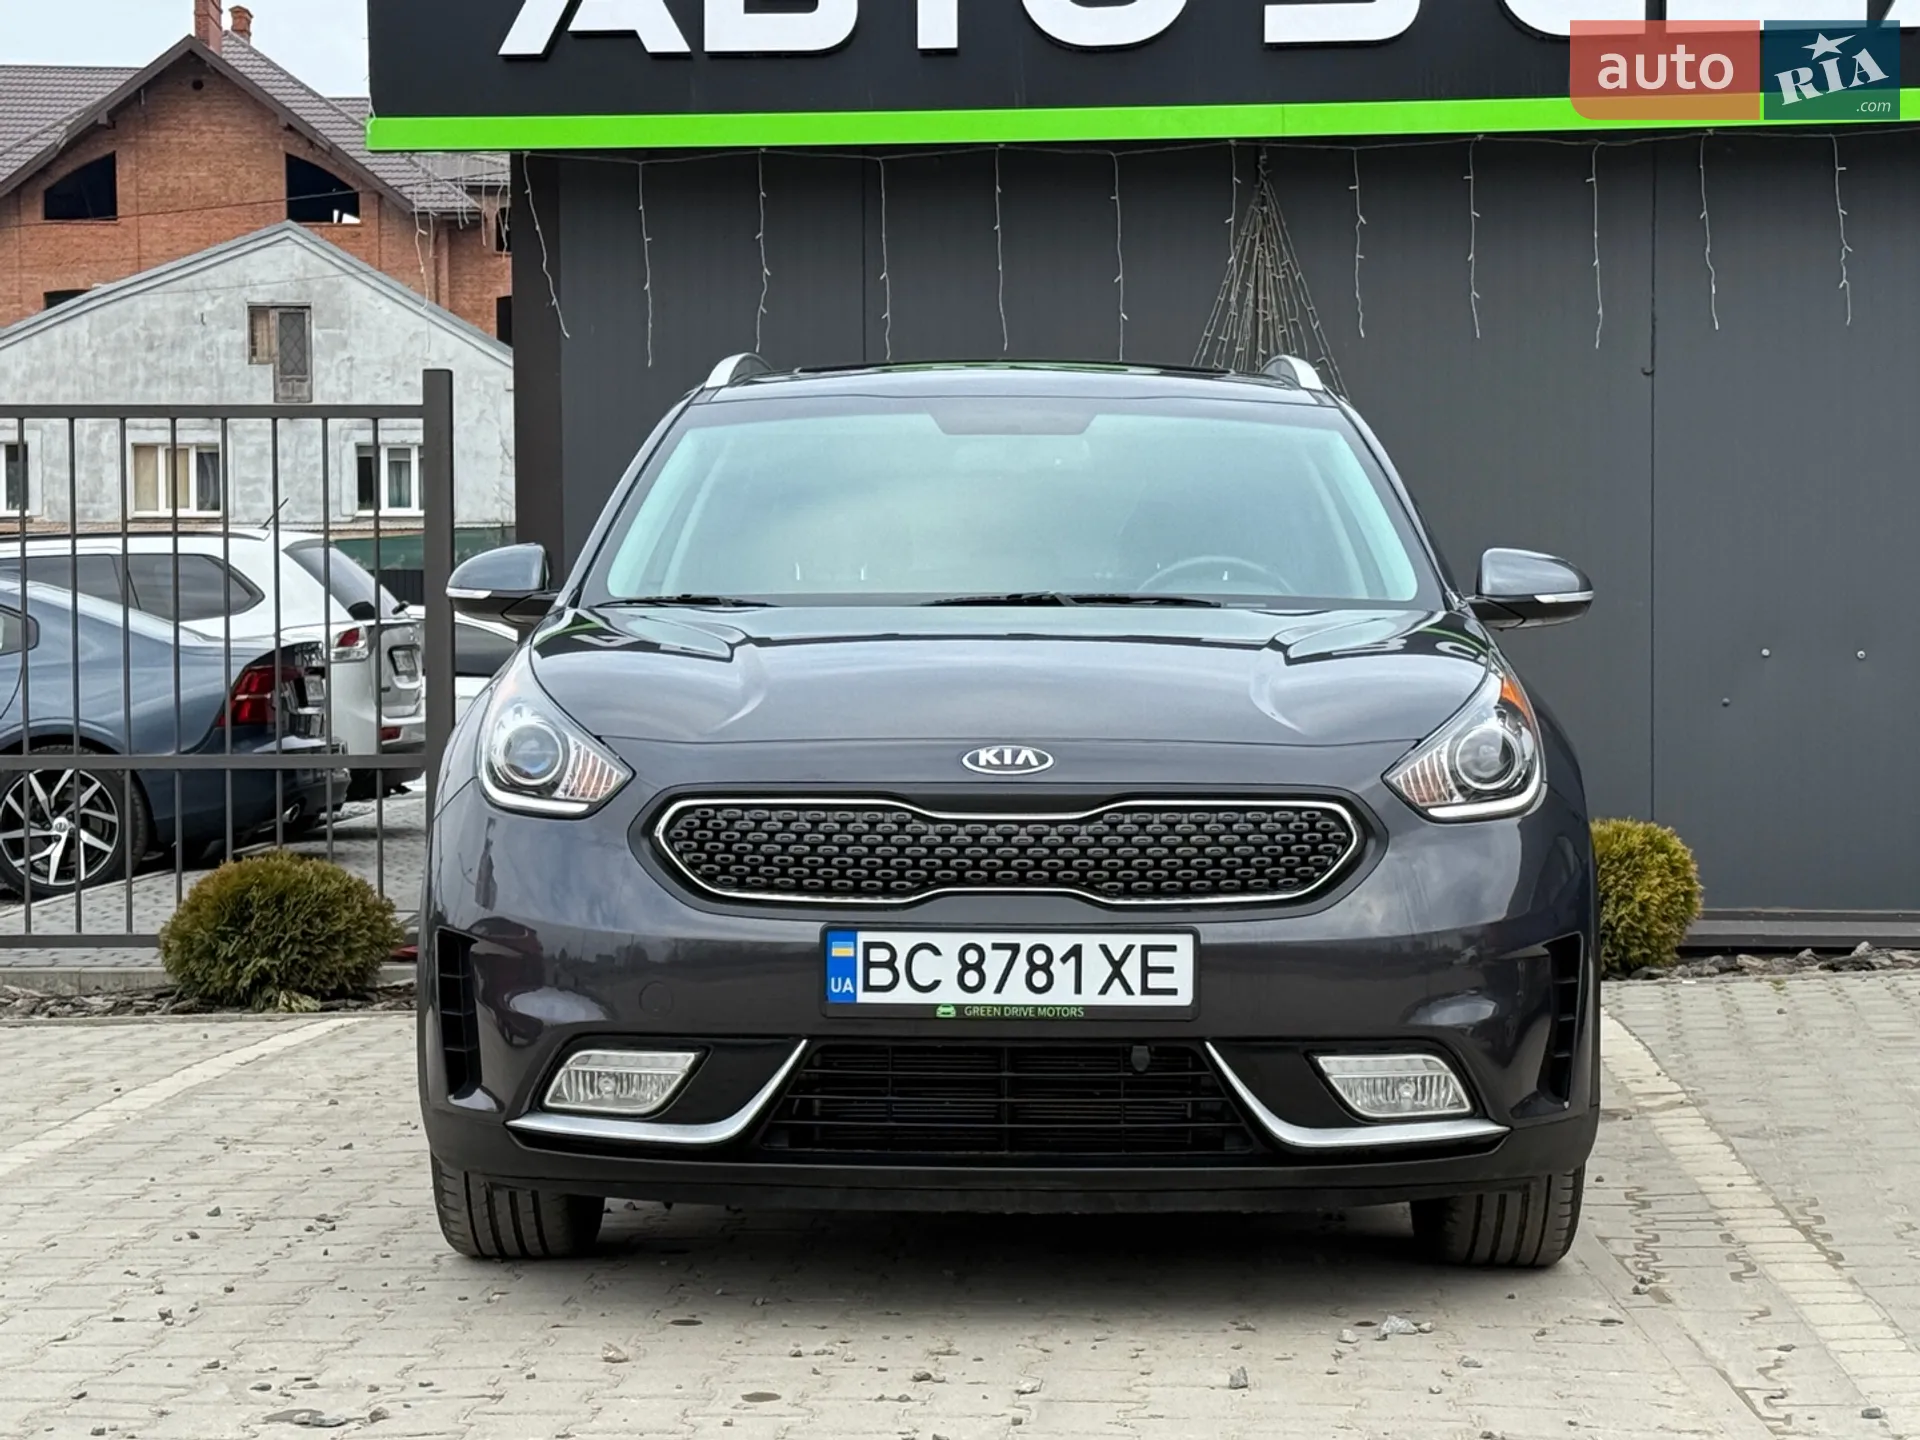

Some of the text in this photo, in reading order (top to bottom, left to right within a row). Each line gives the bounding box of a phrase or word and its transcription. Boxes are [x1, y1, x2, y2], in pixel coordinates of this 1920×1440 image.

[978, 748, 1039, 767] KIA
[862, 940, 1179, 996] BC 8781 XE
[830, 976, 855, 994] UA
[964, 1006, 1085, 1018] GREEN DRIVE MOTORS
